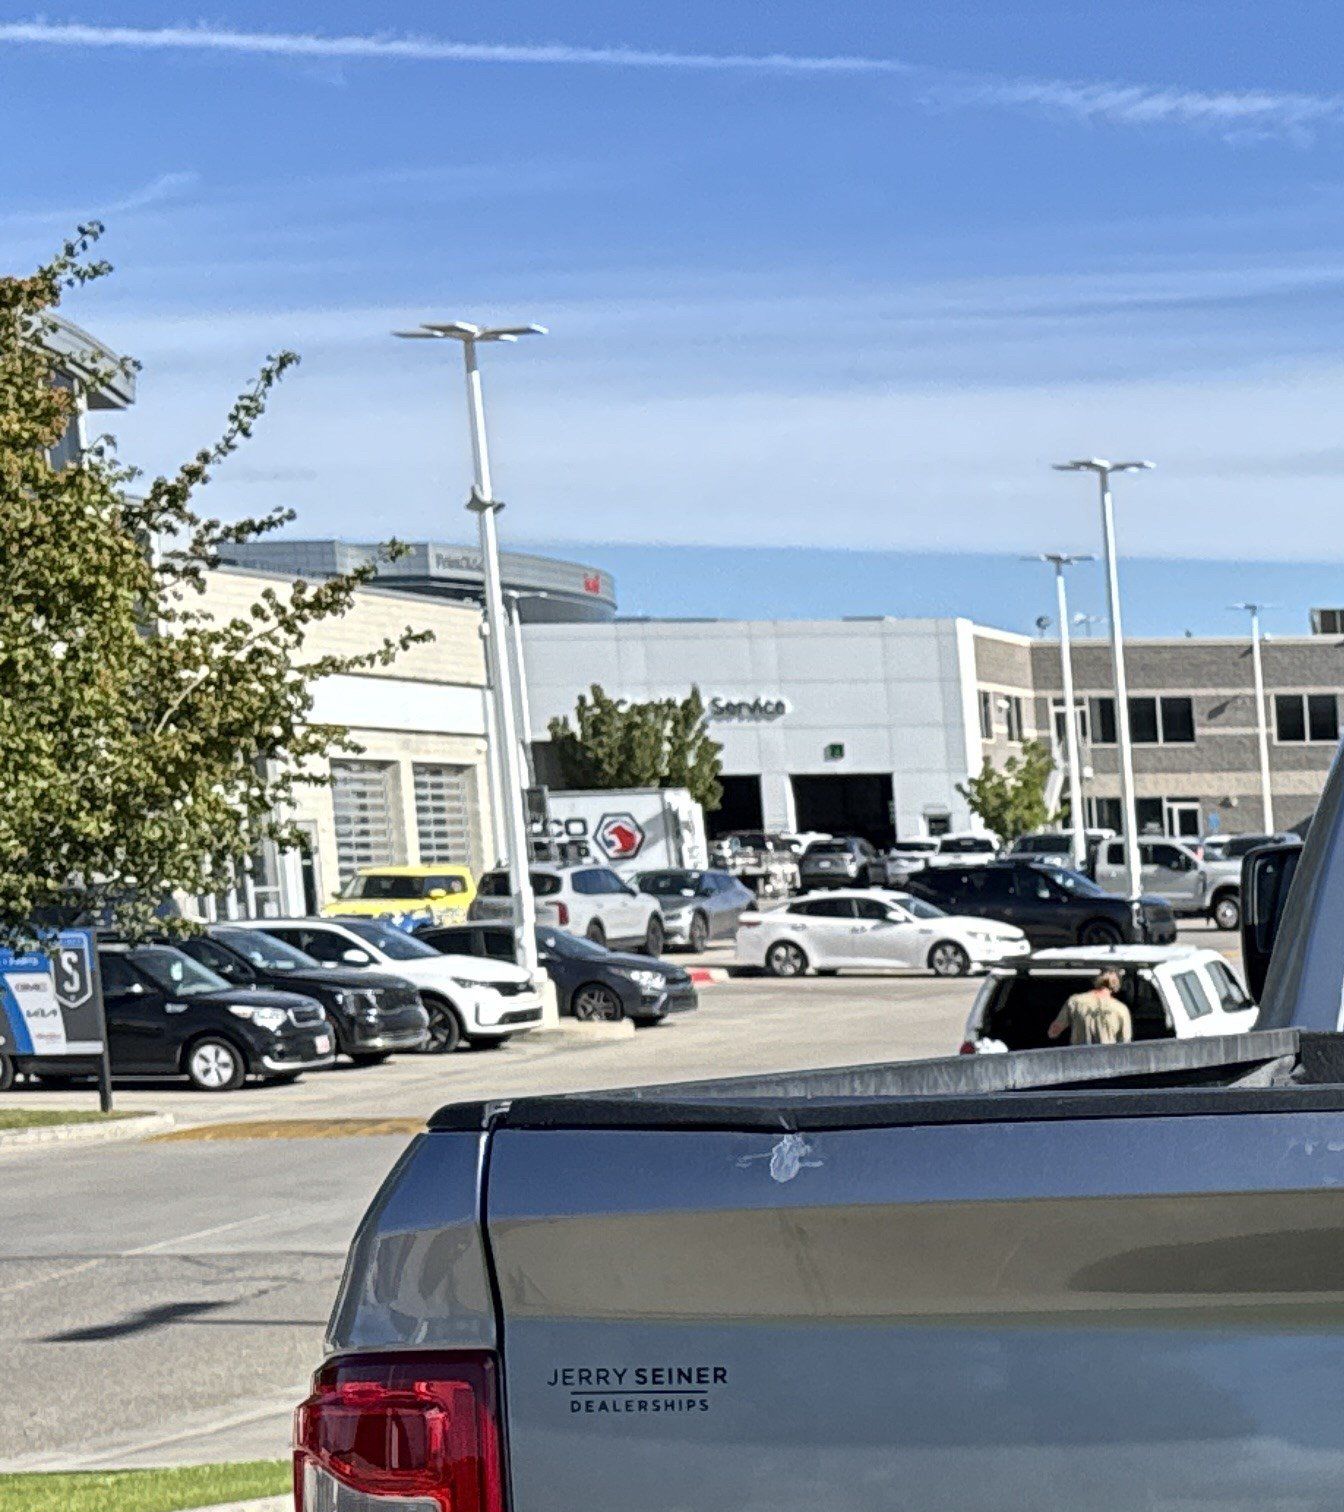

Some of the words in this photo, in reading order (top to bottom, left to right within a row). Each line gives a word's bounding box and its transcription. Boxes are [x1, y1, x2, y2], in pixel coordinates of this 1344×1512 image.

[710, 697, 786, 718] Service
[547, 1367, 628, 1387] JERRY
[634, 1366, 728, 1385] SEINER
[570, 1399, 709, 1414] DEALERSHIPS
